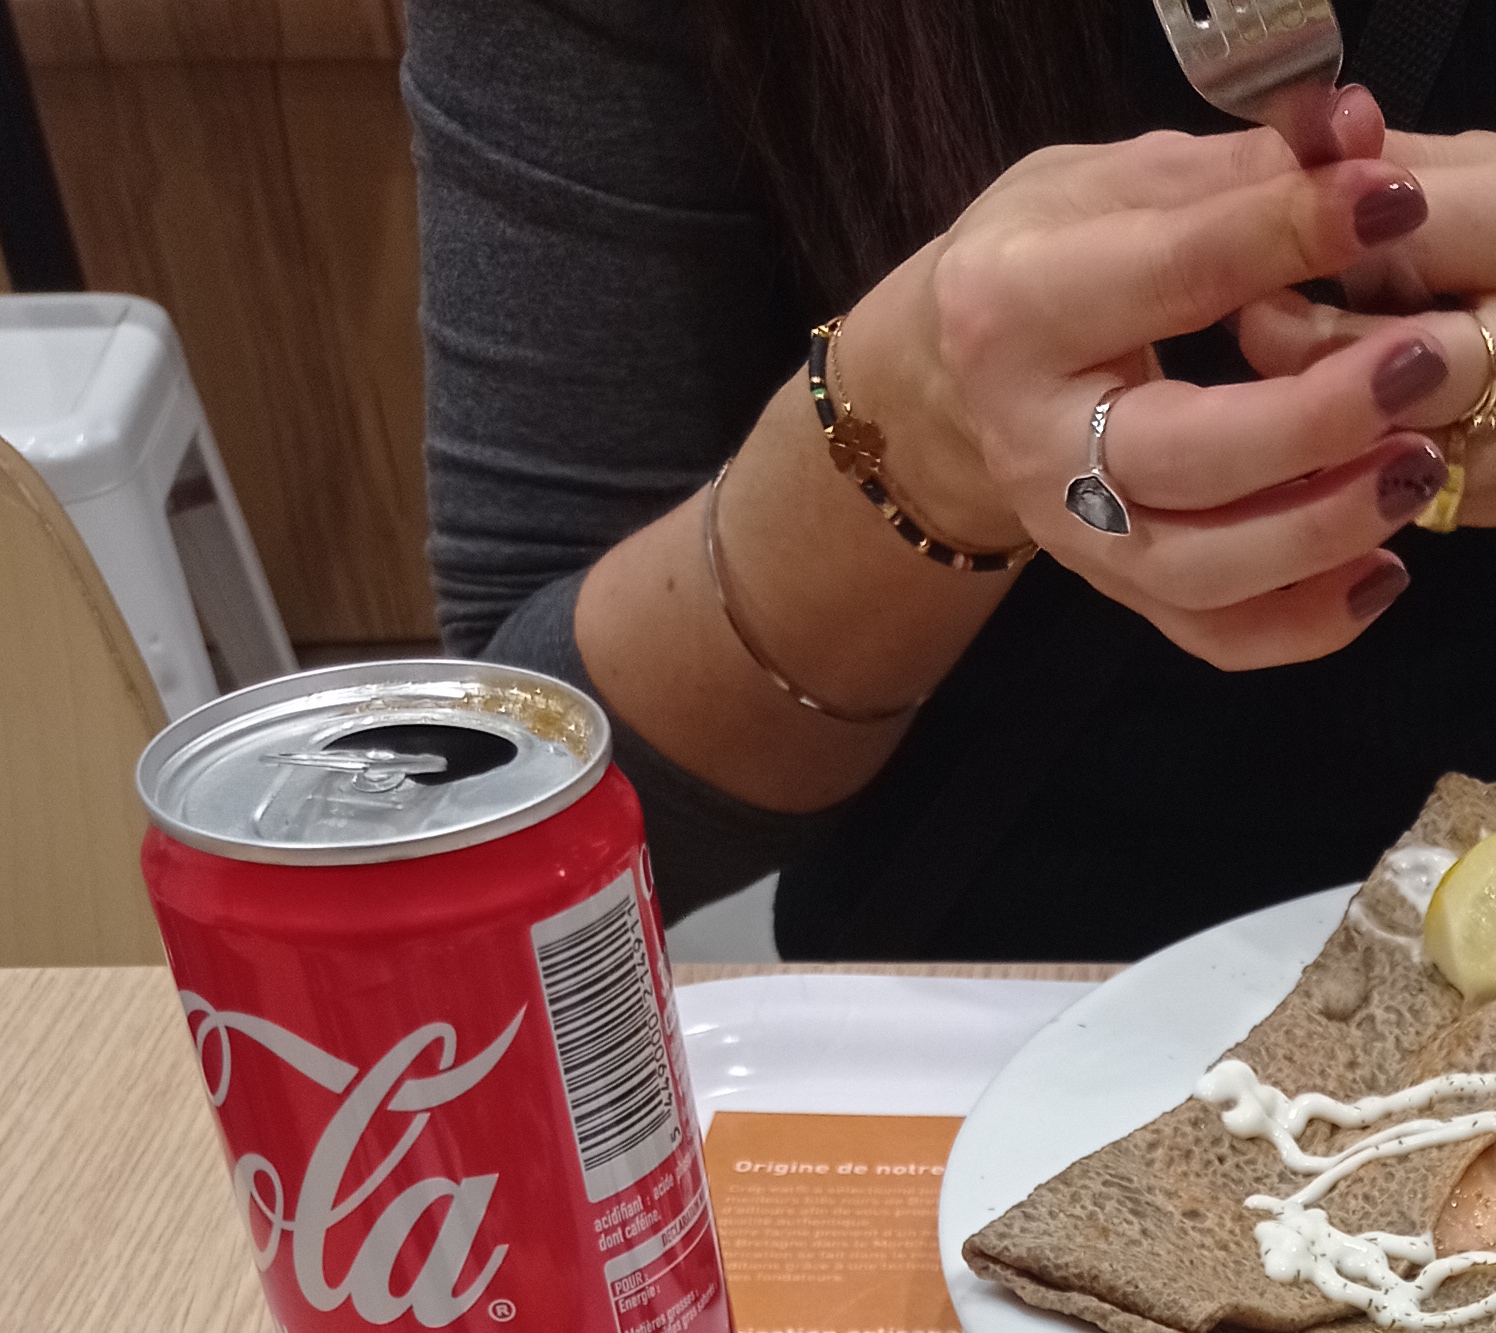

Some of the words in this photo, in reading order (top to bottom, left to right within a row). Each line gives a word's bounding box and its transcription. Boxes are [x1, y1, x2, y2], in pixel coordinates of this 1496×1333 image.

[180, 990, 528, 1328] ola
[734, 1160, 830, 1177] Origine
[836, 1161, 869, 1175] de
[875, 1162, 945, 1176] notre
[614, 1271, 643, 1296] POUR
